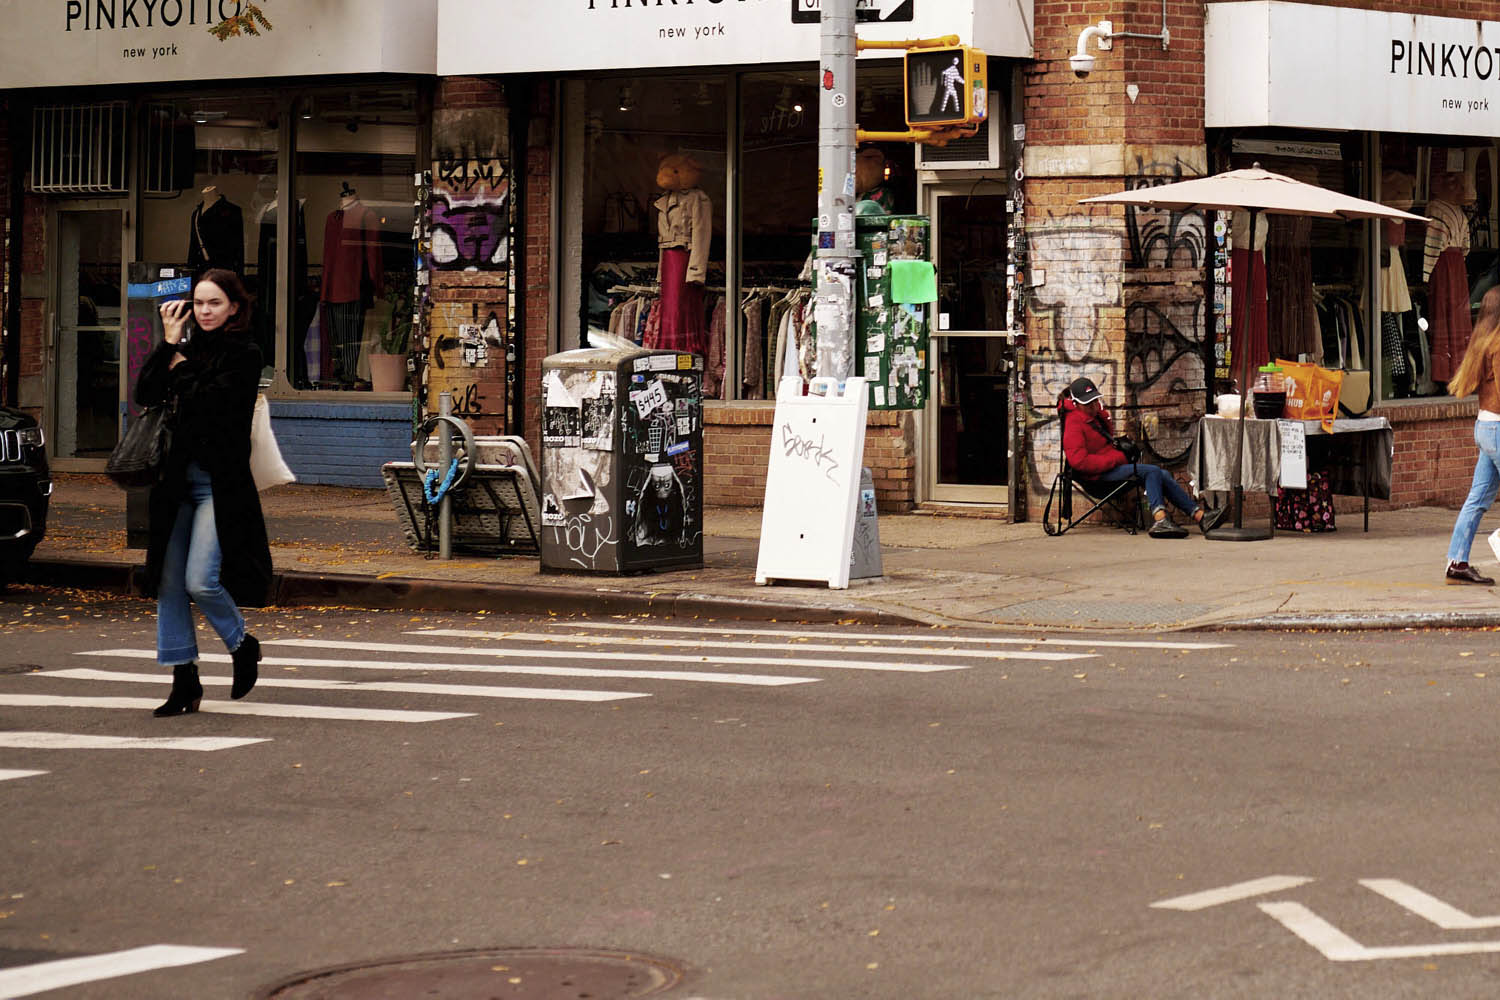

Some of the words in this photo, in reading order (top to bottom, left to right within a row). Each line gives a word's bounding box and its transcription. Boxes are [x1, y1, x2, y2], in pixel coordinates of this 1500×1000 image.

[659, 27, 686, 38] new
[694, 22, 725, 39] york
[123, 48, 145, 58] new
[152, 44, 178, 59] york
[1442, 99, 1462, 109] new
[1468, 98, 1488, 112] york
[638, 388, 662, 411] $445
